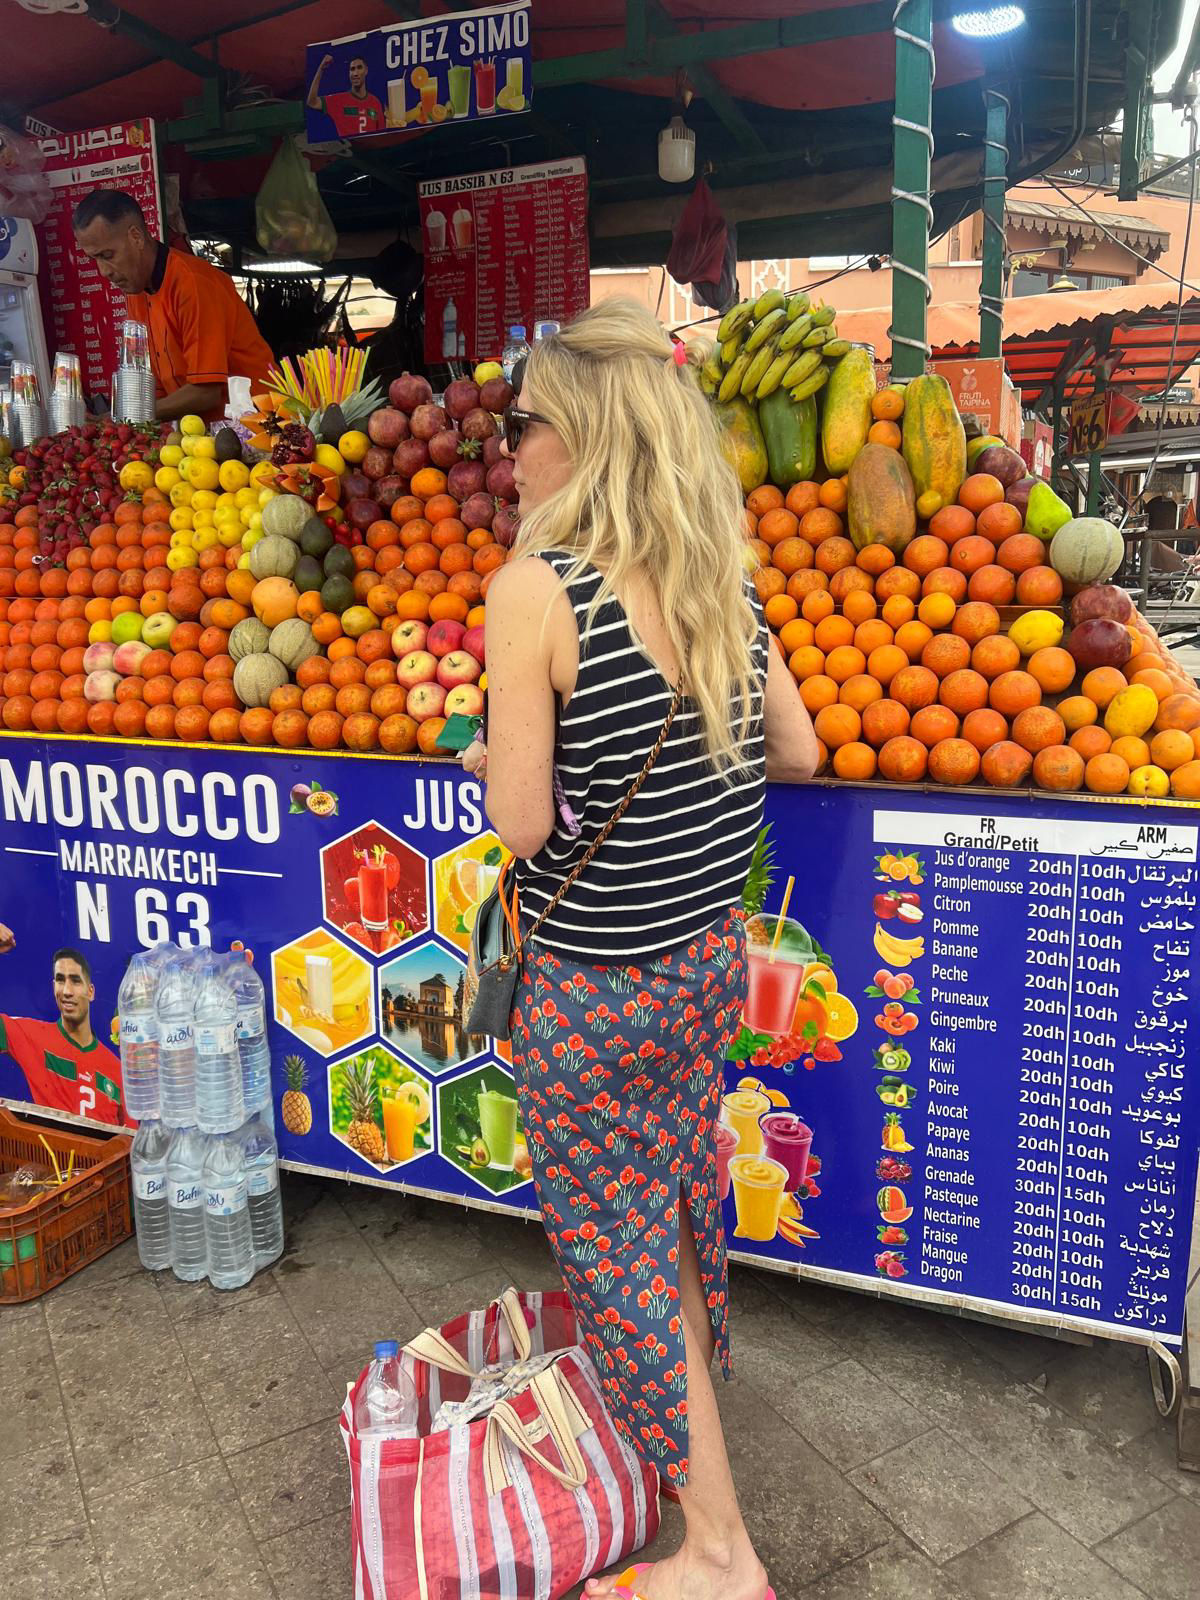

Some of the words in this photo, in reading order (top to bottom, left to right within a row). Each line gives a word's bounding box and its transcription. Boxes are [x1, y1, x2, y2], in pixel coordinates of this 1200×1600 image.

[386, 26, 449, 69] CHEZ
[459, 10, 529, 57] SIMO
[27, 119, 48, 137] JUS
[359, 117, 367, 133] 2
[73, 125, 124, 160] عصير
[420, 181, 441, 196] JUS
[445, 175, 485, 192] BASSIR
[489, 173, 498, 186] N
[501, 171, 514, 184] 63
[959, 392, 981, 400] FRUTI
[0, 758, 280, 844] MOROCCO
[403, 778, 483, 835] JUS
[980, 818, 996, 833] FR
[1137, 826, 1167, 844] ARM
[944, 832, 1039, 852] Grand/Petit
[60, 839, 218, 886] MARRAKECH
[934, 850, 955, 865] Jus
[1028, 859, 1073, 875] 20dh
[1080, 864, 1126, 879] 10dh
[1127, 865, 1198, 889] البرتقال
[934, 873, 1024, 894] Pamplemousse
[1028, 882, 1073, 897] 20dh
[1080, 886, 1125, 902] 10dh
[1140, 891, 1197, 911] بلموس
[75, 881, 111, 943] N
[134, 887, 211, 951] 63
[933, 895, 971, 912] Citron
[1027, 904, 1071, 920] 20dh
[1079, 909, 1124, 925] 10dh
[1138, 914, 1195, 932] حامض
[933, 918, 979, 936] Pomme
[1026, 928, 1070, 944] 20dh
[1077, 934, 1122, 950] 10dh
[932, 940, 978, 958] Banane
[1025, 950, 1069, 967] 20dh
[1076, 956, 1121, 973] 10dh
[1152, 940, 1190, 962] تفاح
[932, 964, 969, 981] Peche
[1024, 974, 1068, 991] 20dh
[1075, 981, 1120, 997] 10dh
[1161, 963, 1190, 982] موز
[931, 987, 990, 1007] Pruneaux
[1023, 998, 1066, 1015] 20dh
[1073, 1005, 1118, 1021] 10dh
[1151, 985, 1189, 1007] خوخ
[930, 1011, 997, 1032] Gingembre
[1022, 1024, 1065, 1040] 20dh
[1072, 1030, 1116, 1047] 10dh
[1134, 1011, 1188, 1033] برقوق
[929, 1037, 956, 1053] Kaki
[1021, 1048, 1064, 1064] 20dh
[1071, 1055, 1115, 1072] 10dh
[1124, 1035, 1186, 1058] زنجبيل
[929, 1058, 955, 1074] Kiwi
[1020, 1069, 1063, 1085] 20dh
[1069, 1076, 1113, 1093] 10dh
[1144, 1063, 1186, 1082] كاكي
[80, 1085, 96, 1118] 2
[928, 1079, 960, 1095] Poire
[1019, 1090, 1061, 1107] 20dh
[1068, 1098, 1112, 1115] 10dh
[1140, 1087, 1184, 1104] كيوي
[927, 1101, 969, 1119] Avocat
[1018, 1113, 1060, 1130] 20dh
[1067, 1121, 1111, 1139] 10dh
[927, 1122, 970, 1143] Papaye
[1017, 1136, 1059, 1152] 20dh
[1066, 1144, 1109, 1161] 10dh
[926, 1143, 970, 1161] Ananas
[1016, 1158, 1058, 1175] 20dh
[1064, 1166, 1108, 1184] 10dh
[925, 1166, 975, 1185] Grenade
[1014, 1179, 1055, 1195] 30dh
[1063, 1187, 1105, 1204] 15dh
[924, 1186, 979, 1207] Pasteque
[1014, 1201, 1056, 1218] 20dh
[1062, 1209, 1106, 1227] 10dh
[1140, 1199, 1175, 1219] رمان
[923, 1207, 981, 1228] Nectarine
[1012, 1222, 1055, 1239] 20dh
[1061, 1230, 1105, 1248] 10dh
[1138, 1220, 1174, 1239] دلاح
[923, 1226, 958, 1244] Fraise
[1012, 1242, 1054, 1259] 20dh
[1060, 1250, 1104, 1269] 10dh
[922, 1243, 968, 1264] Mangue
[1011, 1262, 1053, 1280] 20dh
[1059, 1271, 1102, 1290] 10dh
[920, 1261, 963, 1282] Dragon
[1011, 1283, 1052, 1301] 30dh
[1060, 1292, 1101, 1310] 15dh
